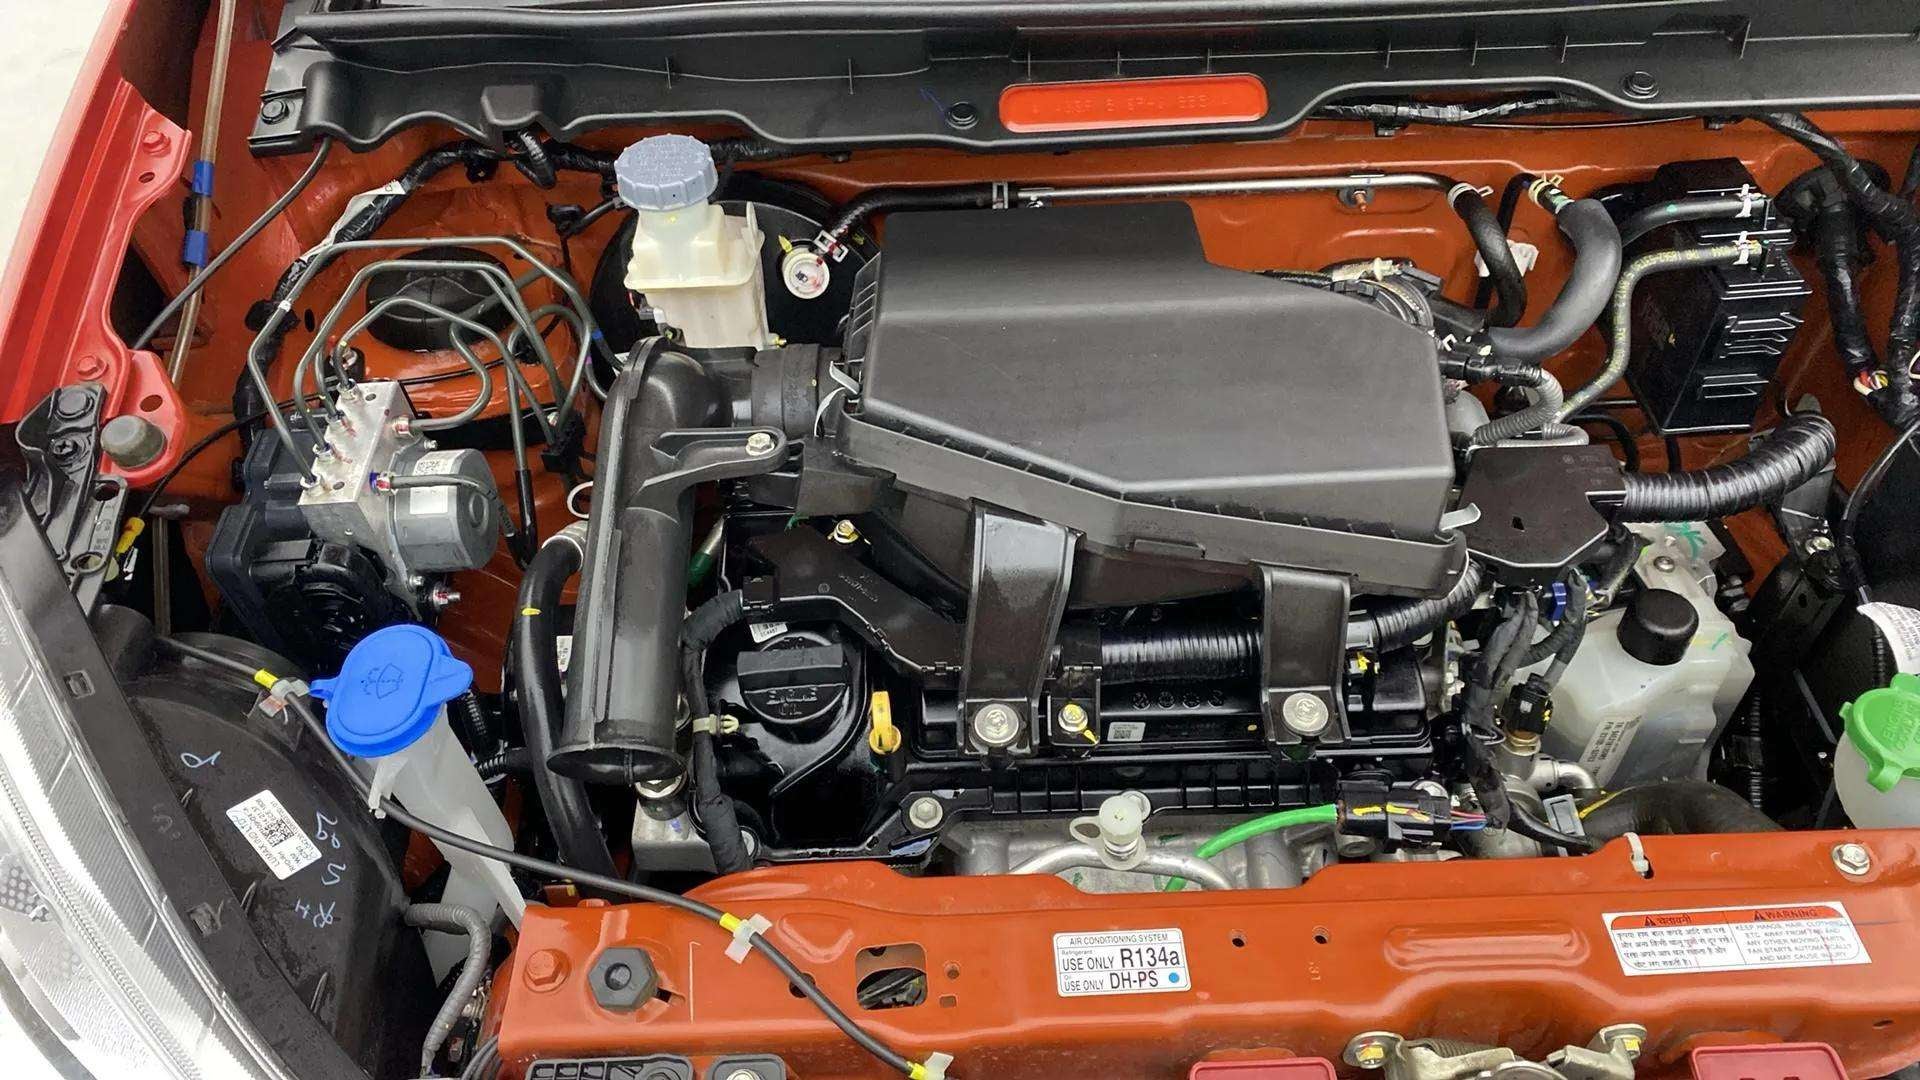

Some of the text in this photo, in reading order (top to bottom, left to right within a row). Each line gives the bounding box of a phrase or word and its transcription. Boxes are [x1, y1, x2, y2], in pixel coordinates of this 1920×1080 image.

[1882, 701, 1906, 739] ENGINE
[258, 843, 280, 867] LUMAX
[1766, 909, 1818, 919] WARNING
[1070, 933, 1169, 945] AIR CONDITIONING SYSTEM
[1063, 946, 1180, 971] USE ONLY R134a
[1064, 970, 1159, 991] USE ONLY DH-PS
